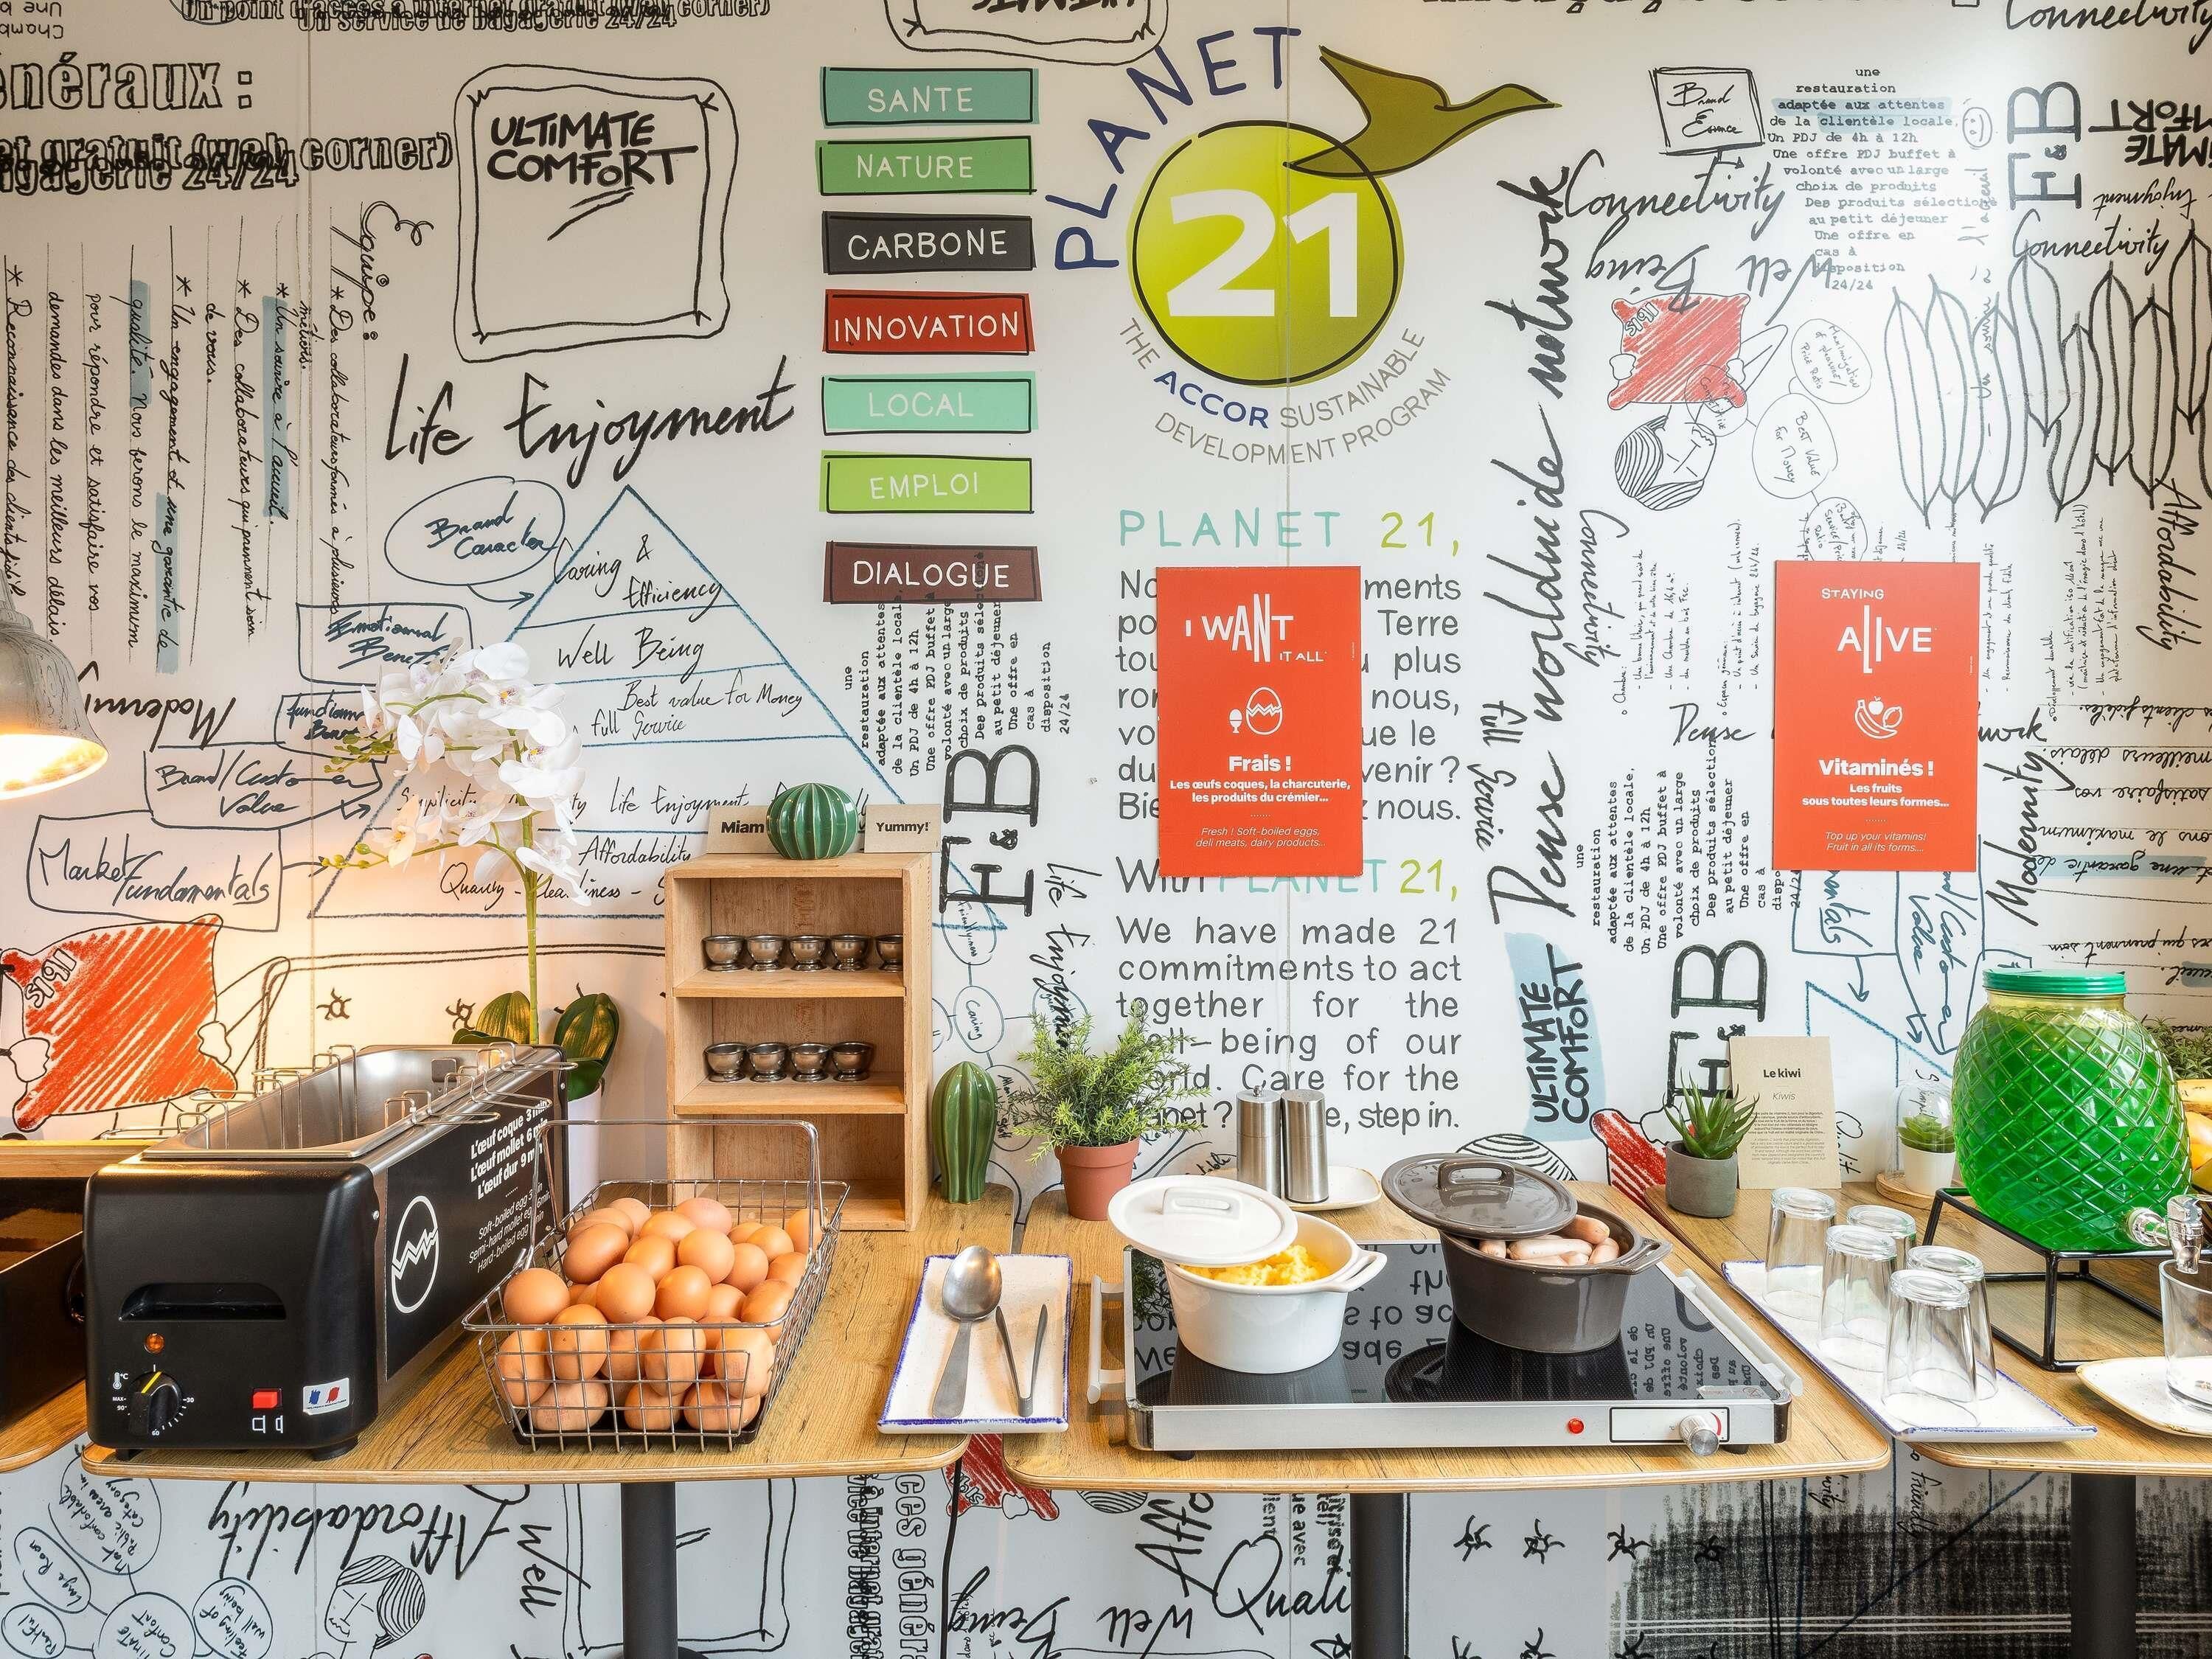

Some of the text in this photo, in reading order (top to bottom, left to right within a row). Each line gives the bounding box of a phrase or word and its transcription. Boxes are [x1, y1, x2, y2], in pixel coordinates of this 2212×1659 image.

[1796, 83, 1896, 93] restauration
[1855, 69, 1880, 77] une
[868, 86, 973, 114] SANTE
[1778, 100, 1945, 112] adaptée aux attentes
[490, 111, 655, 150] ULTIMATE
[1045, 26, 1301, 270] PLANET
[486, 145, 699, 188] COMFORT
[856, 154, 973, 178] NATURE
[1564, 149, 1786, 241] Connectivity
[848, 228, 1007, 260] CARBONE
[1166, 188, 1357, 318] 21
[2012, 209, 2170, 276] Connectivity
[834, 311, 1018, 342] INNOVATION
[1119, 317, 1426, 428] THE ACCOR SUSTAINABLE
[869, 392, 974, 417] LOCAL
[1154, 366, 1452, 465] DEVELOPMENT PROGRAM
[385, 353, 796, 489] Life Enjoyment
[870, 472, 978, 500] EMPLOI
[1119, 508, 1460, 557] PLANET 21,
[853, 560, 1010, 588] DIALOGUE
[2138, 476, 2202, 651] Affordability
[622, 576, 722, 623] Efficiency
[1564, 509, 1630, 667] Connectivity
[1821, 588, 1884, 599] STAYING
[1186, 594, 1294, 663] I WANT
[1378, 609, 1458, 636] Terre
[558, 624, 704, 684] Well Being
[1837, 605, 1932, 673] ALIVE
[1279, 652, 1291, 661] IT
[1394, 646, 1461, 680] plus
[617, 680, 658, 711] Best
[669, 679, 724, 708] value
[756, 684, 803, 717] Money
[1372, 688, 1459, 715] nous,
[1411, 720, 1436, 746] le
[1228, 754, 1281, 772] Frais
[1818, 758, 1924, 776] Vitaminés
[1170, 779, 1351, 791] Les œufs coques, la charcuterie,
[1192, 793, 1209, 803] les
[1211, 792, 1258, 804] produits
[1259, 793, 1274, 803] du
[1849, 783, 1902, 793] Les fruits
[1377, 799, 1461, 820] nous.
[1607, 782, 1617, 846] attentes
[1802, 796, 1950, 807] sous toutes leurs formes...
[721, 820, 765, 834] Miam
[875, 822, 929, 835] Yummy!
[1201, 827, 1227, 836] Fresh
[1237, 827, 1291, 836] Soft-boiled
[1293, 828, 1320, 838] eggs,
[1826, 832, 1927, 842] Top up your vitamins!
[1983, 746, 2076, 926] Modernity
[1196, 838, 1214, 848] deli
[1217, 839, 1248, 849] meats,
[1250, 838, 1275, 849] dairy
[1826, 843, 1848, 851] Fruit
[1851, 843, 1859, 851] in
[1862, 843, 1872, 852] all
[1874, 843, 1885, 852] its
[1400, 859, 1458, 901] 21,
[1590, 829, 1601, 927] restauration
[1116, 916, 1456, 945] We have made 21
[1607, 887, 1620, 945] adaptée
[1118, 954, 1462, 981] commitments to act
[1116, 990, 1458, 1024] together for the
[1346, 1026, 1380, 1054] of
[1406, 1032, 1462, 1054] our
[1546, 942, 1590, 1123] COMFORT
[1520, 980, 1560, 1123] ULTIMATE
[1242, 1064, 1458, 1092] Care for the
[1763, 1068, 1801, 1078] Le kiwi
[1773, 1091, 1796, 1100] Kiwis
[497, 1115, 524, 1142] coque
[526, 1108, 532, 1121] 3
[1357, 1102, 1459, 1135] step in.
[496, 1133, 524, 1164] mollet
[526, 1127, 532, 1142] 6
[503, 1160, 518, 1180] dur
[521, 1152, 526, 1167] 9
[479, 1202, 515, 1239] Soft-boiled
[515, 1194, 528, 1211] egg
[469, 1226, 503, 1263] Semi-hard
[504, 1211, 523, 1236] mollet
[477, 1224, 529, 1273] Hard-boiled egg
